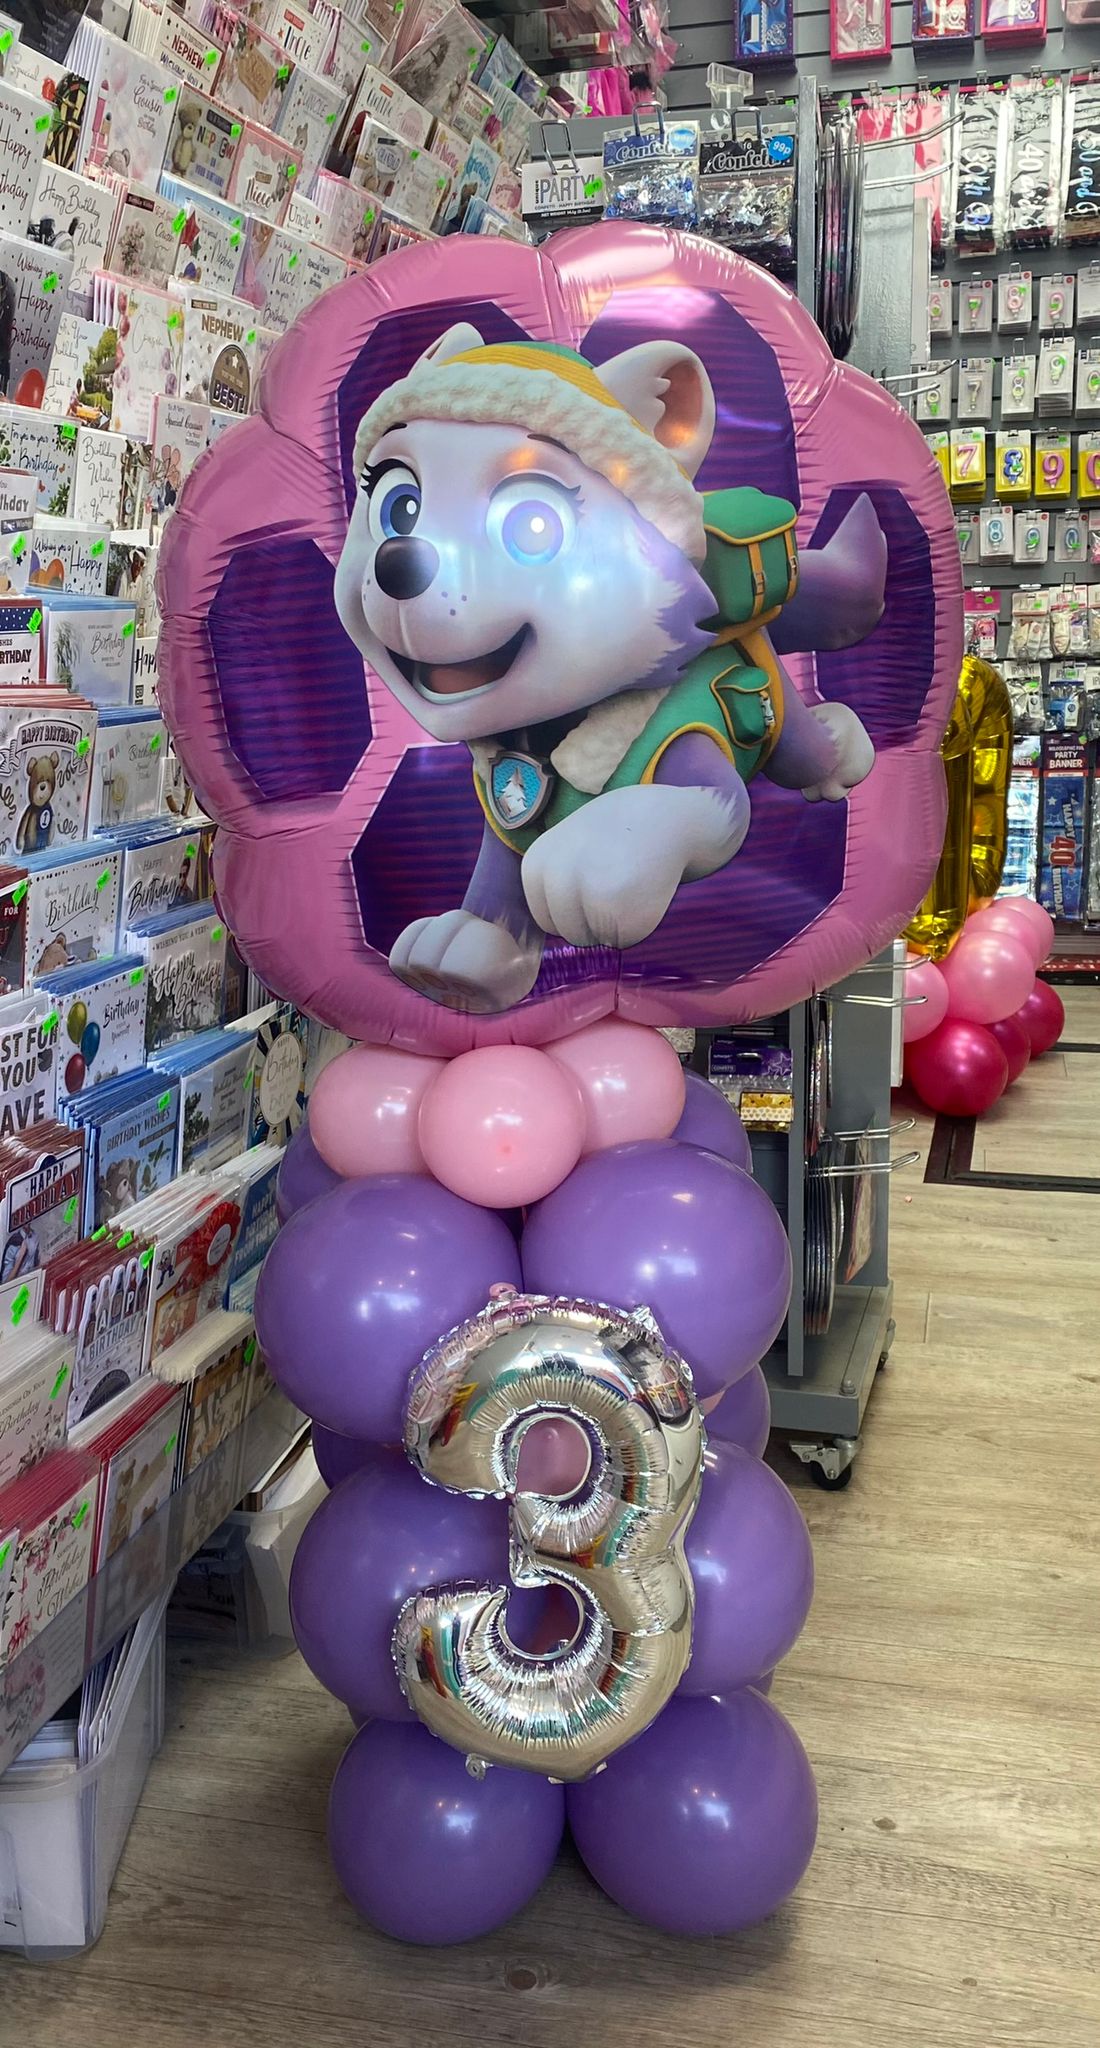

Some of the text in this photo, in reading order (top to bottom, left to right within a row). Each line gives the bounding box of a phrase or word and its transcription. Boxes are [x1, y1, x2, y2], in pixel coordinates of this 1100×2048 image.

[170, 34, 206, 70] NEPHEW
[0, 118, 31, 169] Happy
[773, 141, 792, 155] 99p
[1018, 142, 1045, 171] 40
[39, 173, 66, 215] Happy
[65, 184, 101, 227] Birthday
[288, 202, 311, 230] Uncle
[17, 252, 43, 279] Wishing
[18, 276, 52, 323] Happy
[202, 313, 245, 342] NEPHEW
[19, 446, 59, 482] Birthday
[82, 435, 117, 470] Birthday
[957, 444, 977, 475] 7
[1043, 453, 1064, 481] 9
[34, 536, 57, 556] Wishing
[988, 520, 1003, 543] 8
[70, 543, 102, 580] Happy
[90, 631, 125, 658] Birthday
[21, 725, 79, 745] HAPPY BIRTHDAY
[1049, 759, 1083, 769] BANNER
[1055, 751, 1078, 759] PARTY
[1050, 803, 1076, 916] HAPPY 40 BIRTHDAY
[45, 883, 99, 928] Birthday
[127, 876, 181, 921] Birthday
[154, 952, 194, 1001] Happy
[103, 996, 139, 1028] Birthday
[0, 1021, 59, 1063] ST FOR
[0, 1056, 37, 1092] YOU
[0, 1089, 46, 1137] AVE
[106, 1122, 142, 1153] BIRTHDAY
[29, 1160, 65, 1199] HAPPY
[13, 1169, 79, 1226] BIRTHDAY
[89, 1313, 144, 1360] BIRTHDAY
